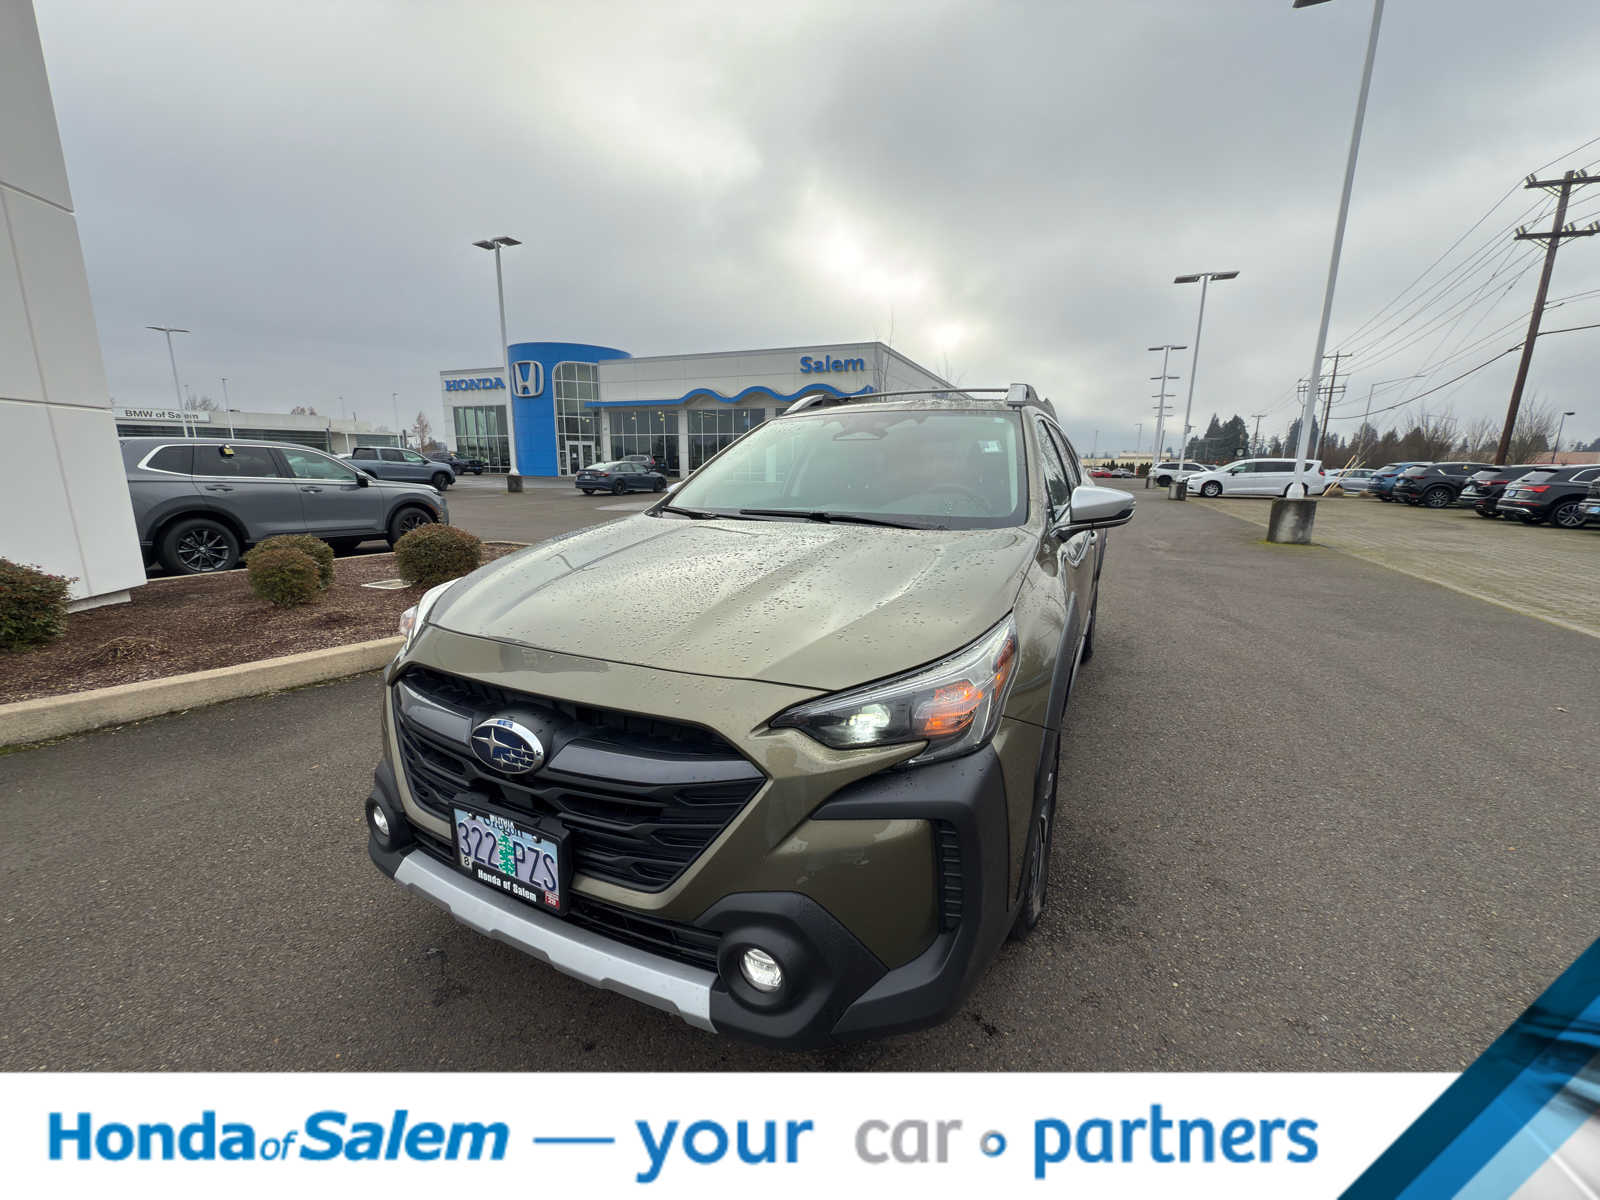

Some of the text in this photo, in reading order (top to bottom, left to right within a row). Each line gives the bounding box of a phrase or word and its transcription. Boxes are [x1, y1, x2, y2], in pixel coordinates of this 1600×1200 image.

[800, 355, 865, 374] Salem
[445, 377, 506, 392] HONDA
[125, 409, 199, 420] BMW of Saem
[458, 822, 557, 892] 322 PZS
[477, 868, 502, 887] Honda
[502, 880, 511, 891] of
[512, 883, 537, 902] Salem
